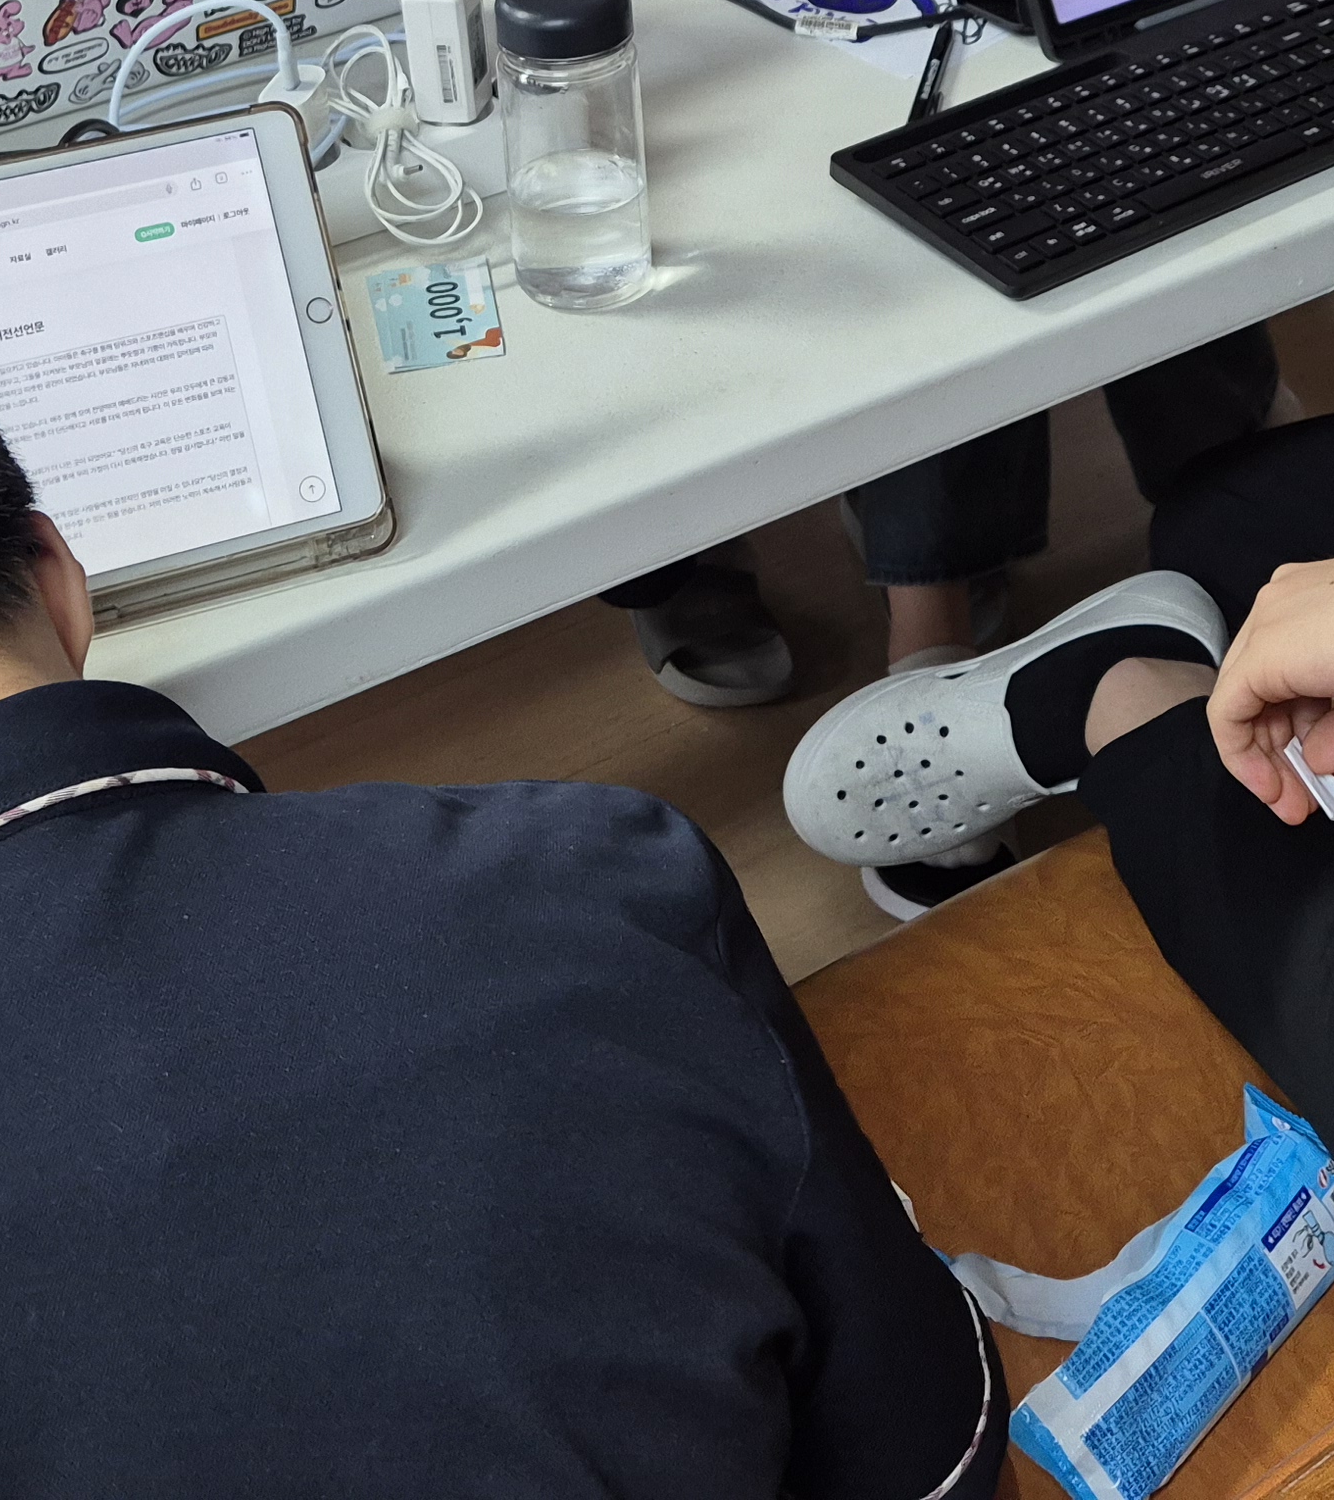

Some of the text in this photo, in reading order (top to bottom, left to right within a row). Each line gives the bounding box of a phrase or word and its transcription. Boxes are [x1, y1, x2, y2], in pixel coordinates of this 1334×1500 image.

[223, 207, 250, 221] 로그아웃
[9, 251, 32, 264] 자료실
[426, 282, 472, 338] 1,000
